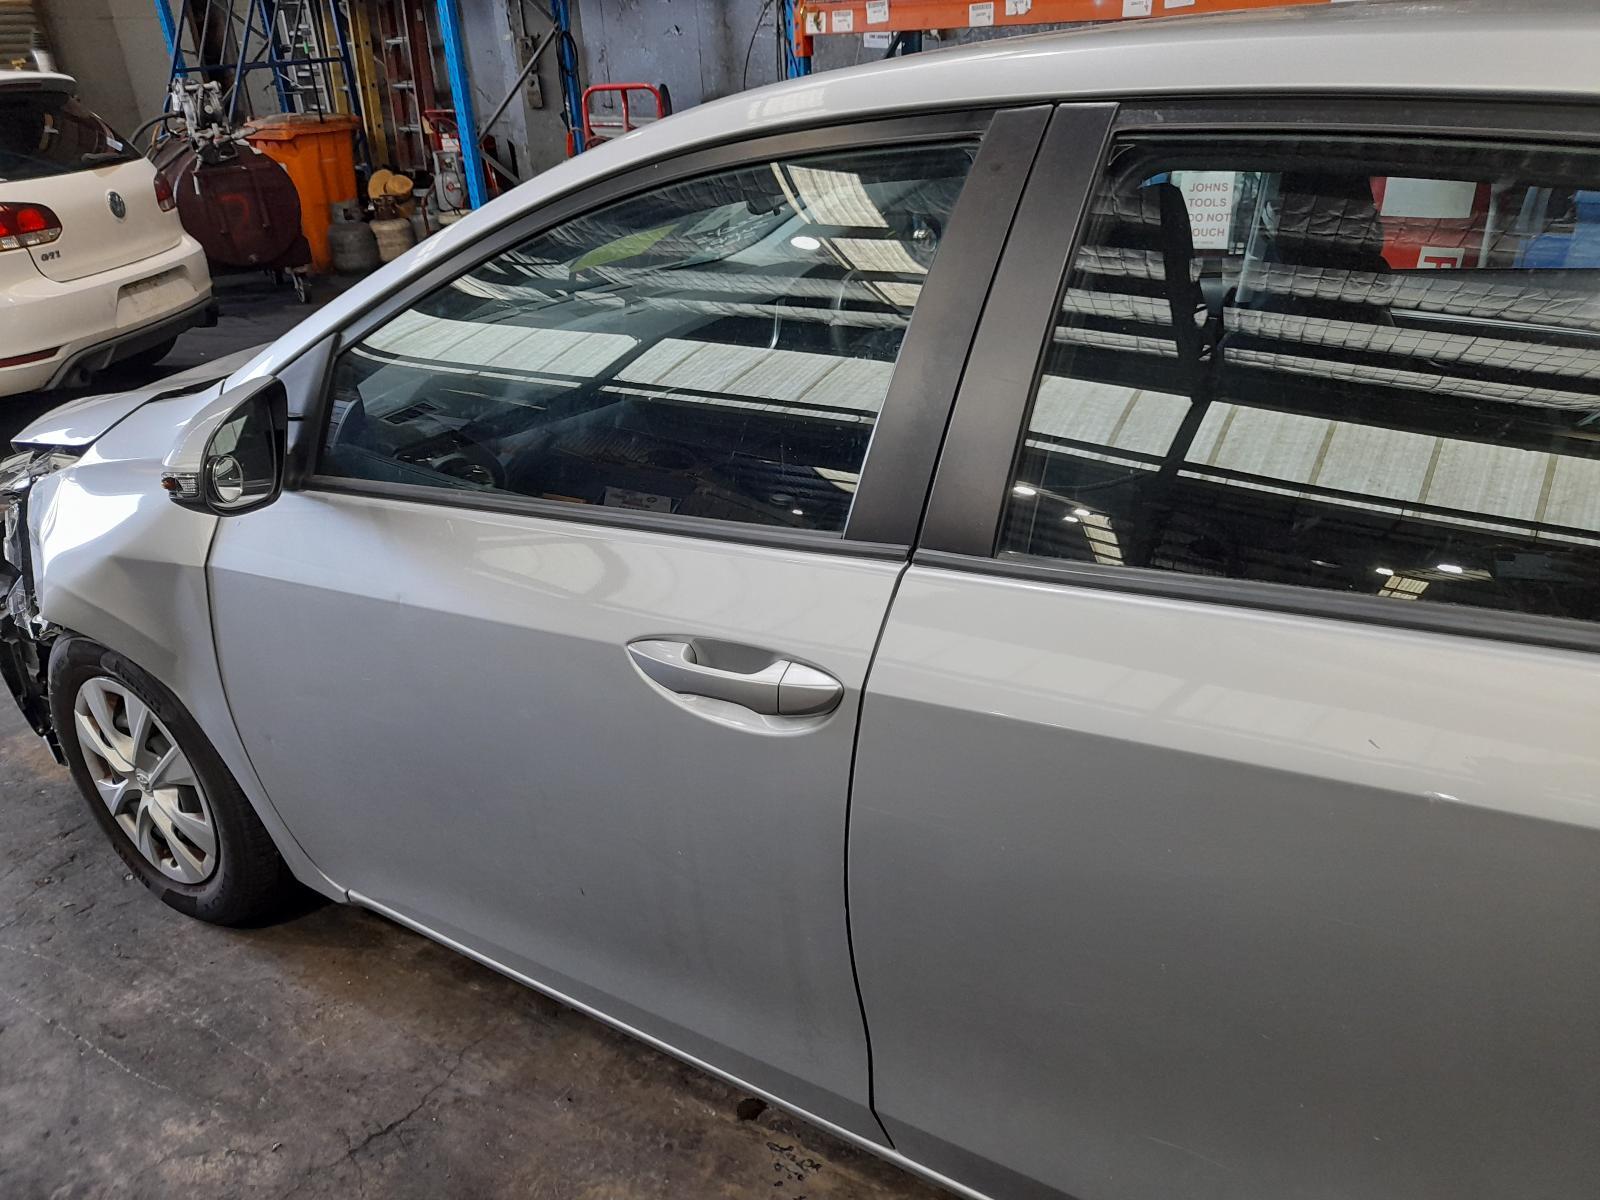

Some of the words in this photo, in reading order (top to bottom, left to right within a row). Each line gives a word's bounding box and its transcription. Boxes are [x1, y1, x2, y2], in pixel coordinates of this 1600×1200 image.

[1190, 183, 1228, 192] JOHNS
[1188, 198, 1227, 207] TOOLS
[1206, 213, 1232, 222] NOT
[1192, 228, 1224, 237] OUCH
